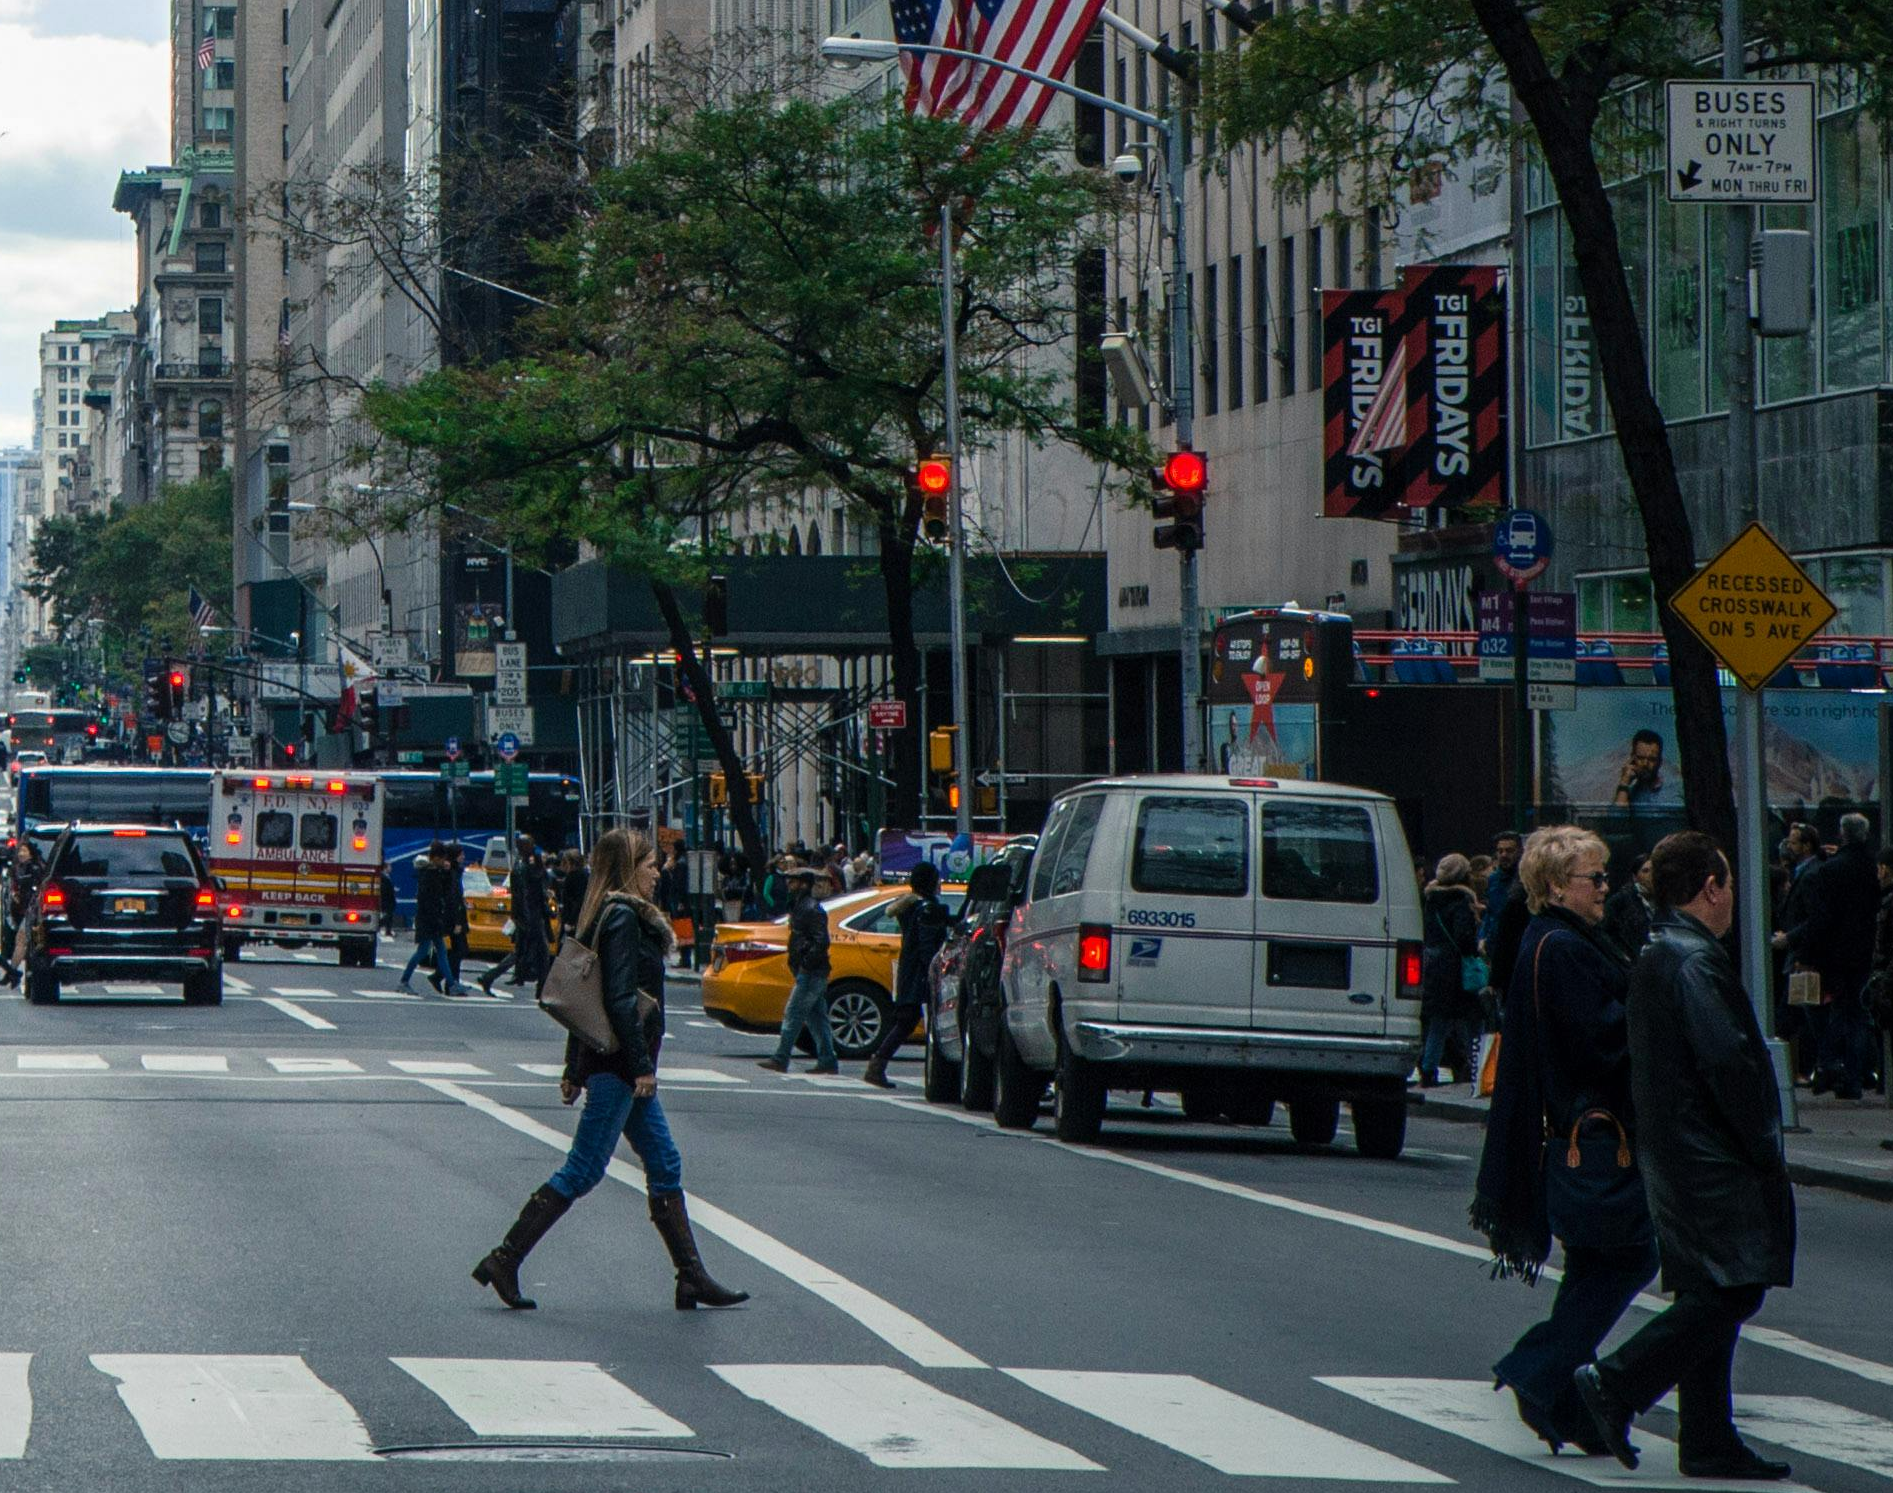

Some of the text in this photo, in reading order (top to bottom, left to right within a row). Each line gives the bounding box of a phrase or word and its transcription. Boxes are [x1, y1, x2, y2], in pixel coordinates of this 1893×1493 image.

[1696, 91, 1786, 114] BUSES
[1696, 118, 1787, 129] & RIGHT TURNS
[1706, 133, 1776, 156] ONLY
[1727, 160, 1793, 174] 7AM-7PM
[1712, 178, 1807, 193] MON THRU FRI
[1435, 295, 1468, 312] TGI
[1351, 317, 1382, 334] TGI
[1435, 315, 1470, 477] FRIDAYS
[1351, 337, 1384, 489] FRIDYS
[1708, 574, 1804, 594] RECESSED
[1481, 594, 1499, 610] M1
[1699, 597, 1812, 619] CROSSWALK
[1481, 616, 1500, 632] M4
[1709, 621, 1802, 641] ON 5 AVE
[502, 646, 519, 656] BUS
[1481, 637, 1507, 654] Q32
[500, 658, 522, 668] LANE
[495, 708, 525, 717] BUSES
[1783, 707, 1800, 716] so
[1807, 704, 1818, 716] in
[1821, 704, 1855, 721] right
[263, 797, 333, 810] F.D. N.Y.
[257, 848, 335, 862] AMBULANCE
[261, 891, 326, 903] KEEP BACK
[1128, 909, 1196, 928] 6933015
